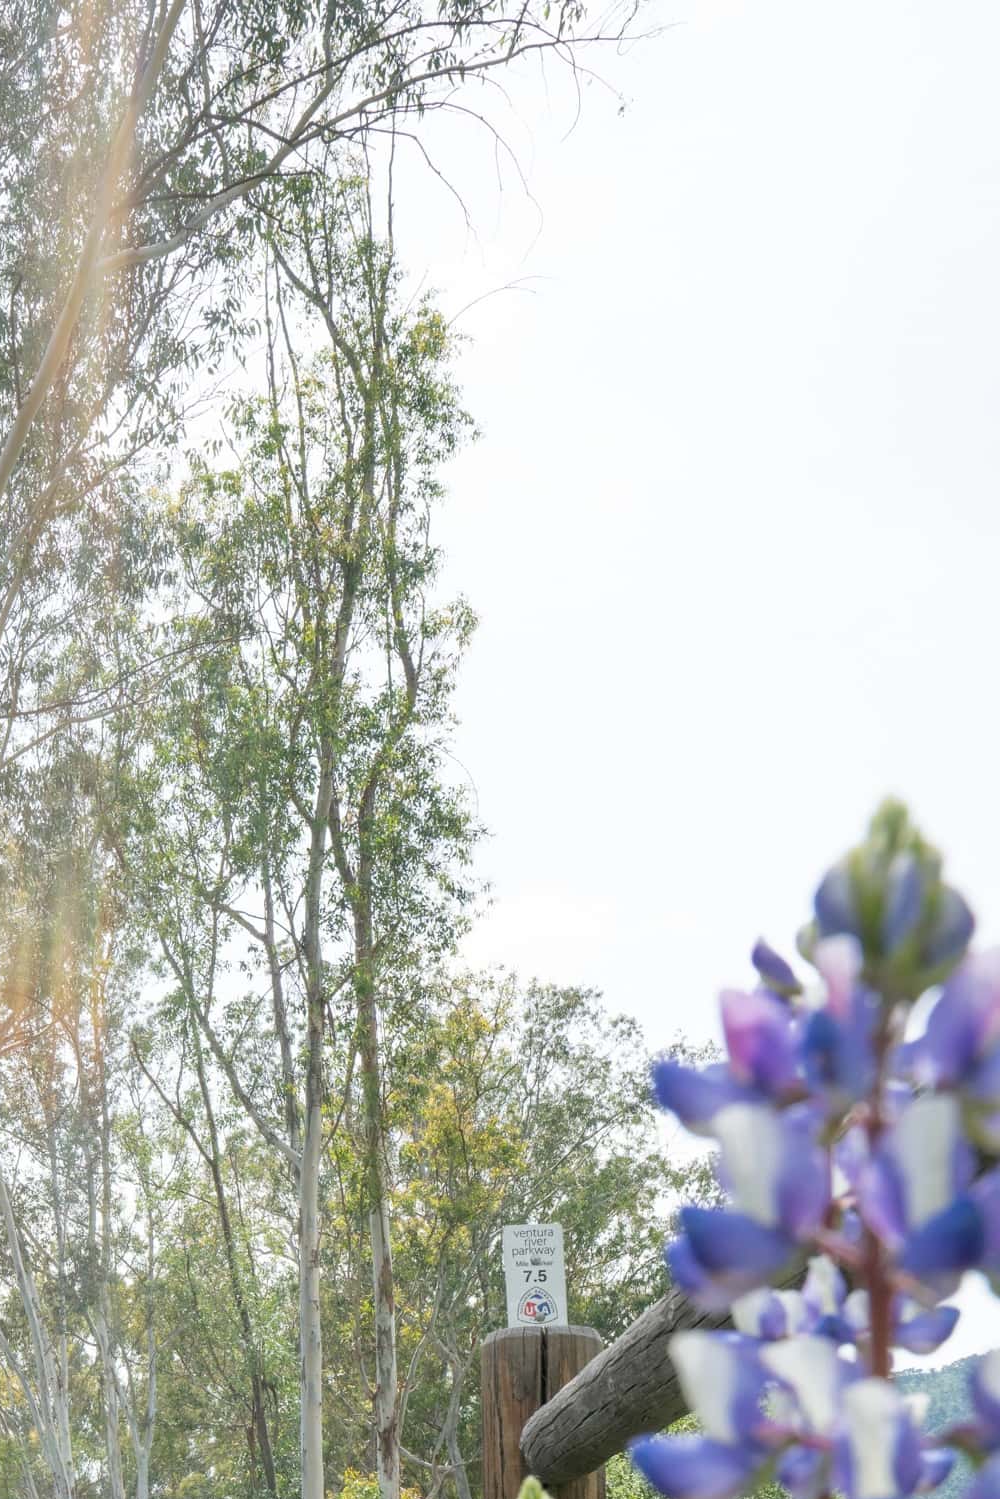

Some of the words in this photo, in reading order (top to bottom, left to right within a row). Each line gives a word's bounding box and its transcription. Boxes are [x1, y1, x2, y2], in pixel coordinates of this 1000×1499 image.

[513, 1229, 554, 1238] ventura
[524, 1238, 547, 1248] river
[511, 1246, 556, 1258] parkway
[523, 1270, 547, 1283] 7.5
